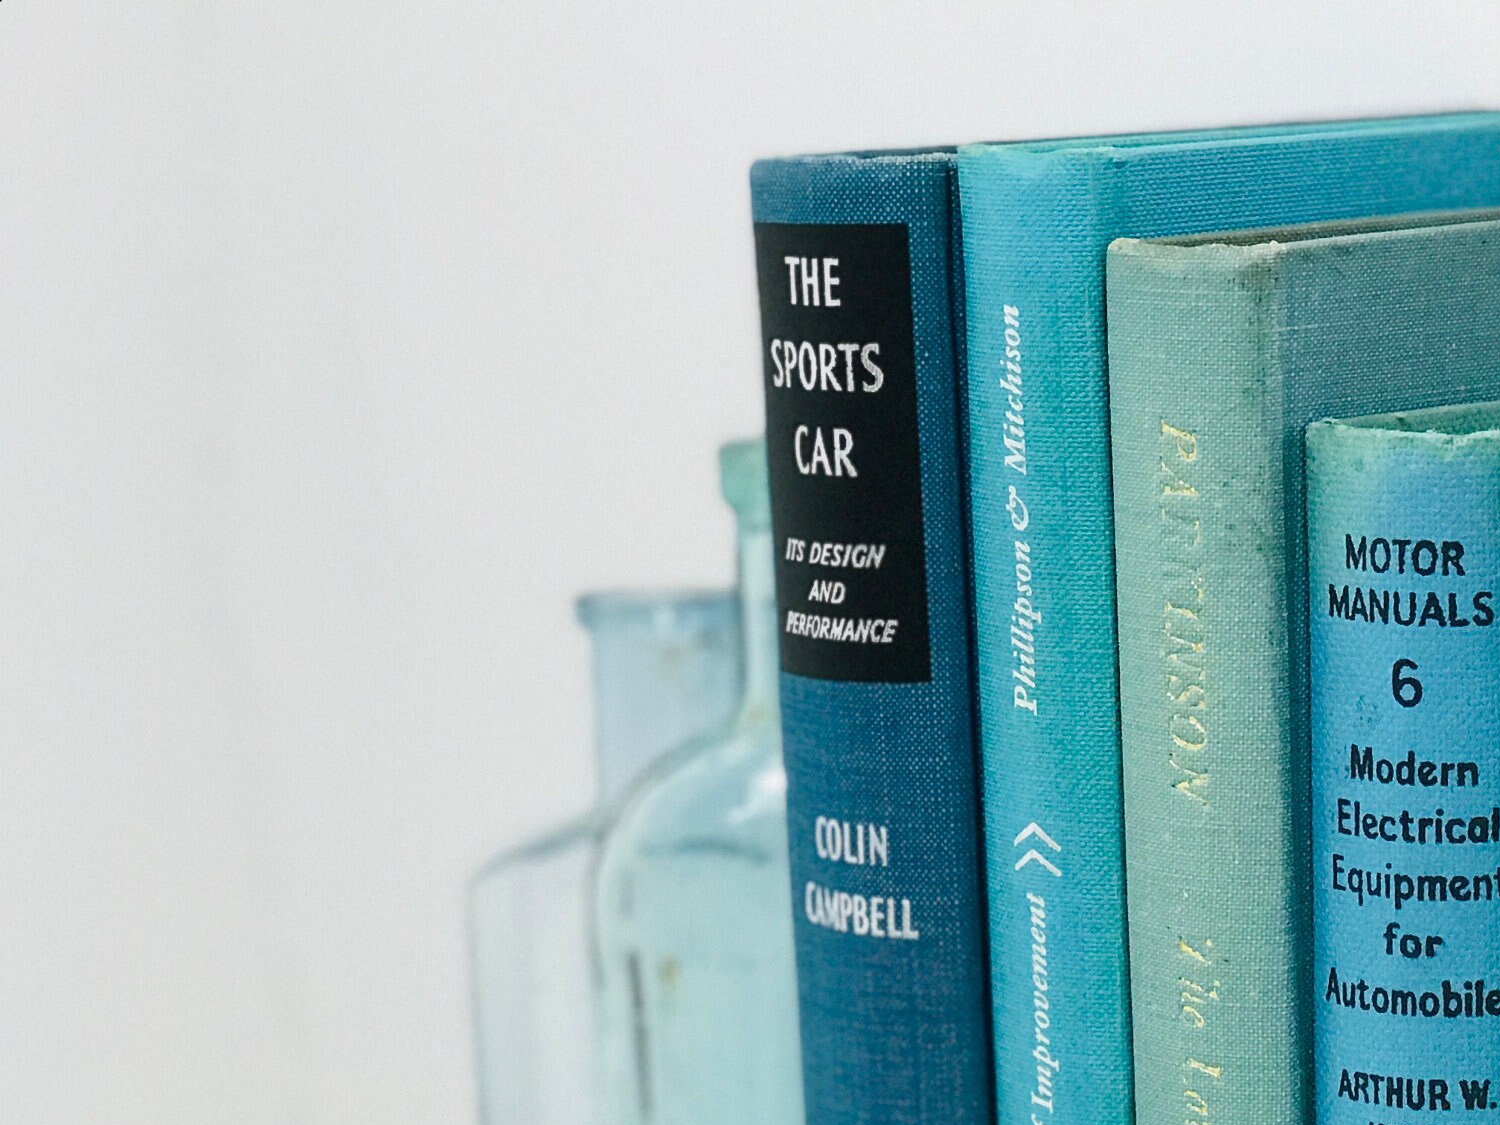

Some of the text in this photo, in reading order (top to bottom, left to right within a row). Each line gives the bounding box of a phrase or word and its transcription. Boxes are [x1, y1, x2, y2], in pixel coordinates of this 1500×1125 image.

[784, 256, 842, 307] THE
[770, 339, 885, 394] SPORTS
[794, 425, 859, 478] CAR
[999, 304, 1042, 716] Phillipson & Mitchison
[785, 537, 887, 570] ITS DESIGN
[1345, 534, 1466, 577] MOTOR
[808, 579, 847, 605] AND
[1328, 584, 1495, 627] MANUALS
[786, 610, 899, 644] PERFORMANCE
[1391, 658, 1423, 708] 6
[1350, 744, 1479, 787] Modern
[815, 815, 888, 867] COLIN
[1337, 798, 1500, 845] Electrical
[805, 881, 919, 940] CAMPBELL
[1383, 922, 1443, 959] for
[1030, 891, 1060, 1113] Improvement
[1337, 1069, 1498, 1111] ARTHUR W.
